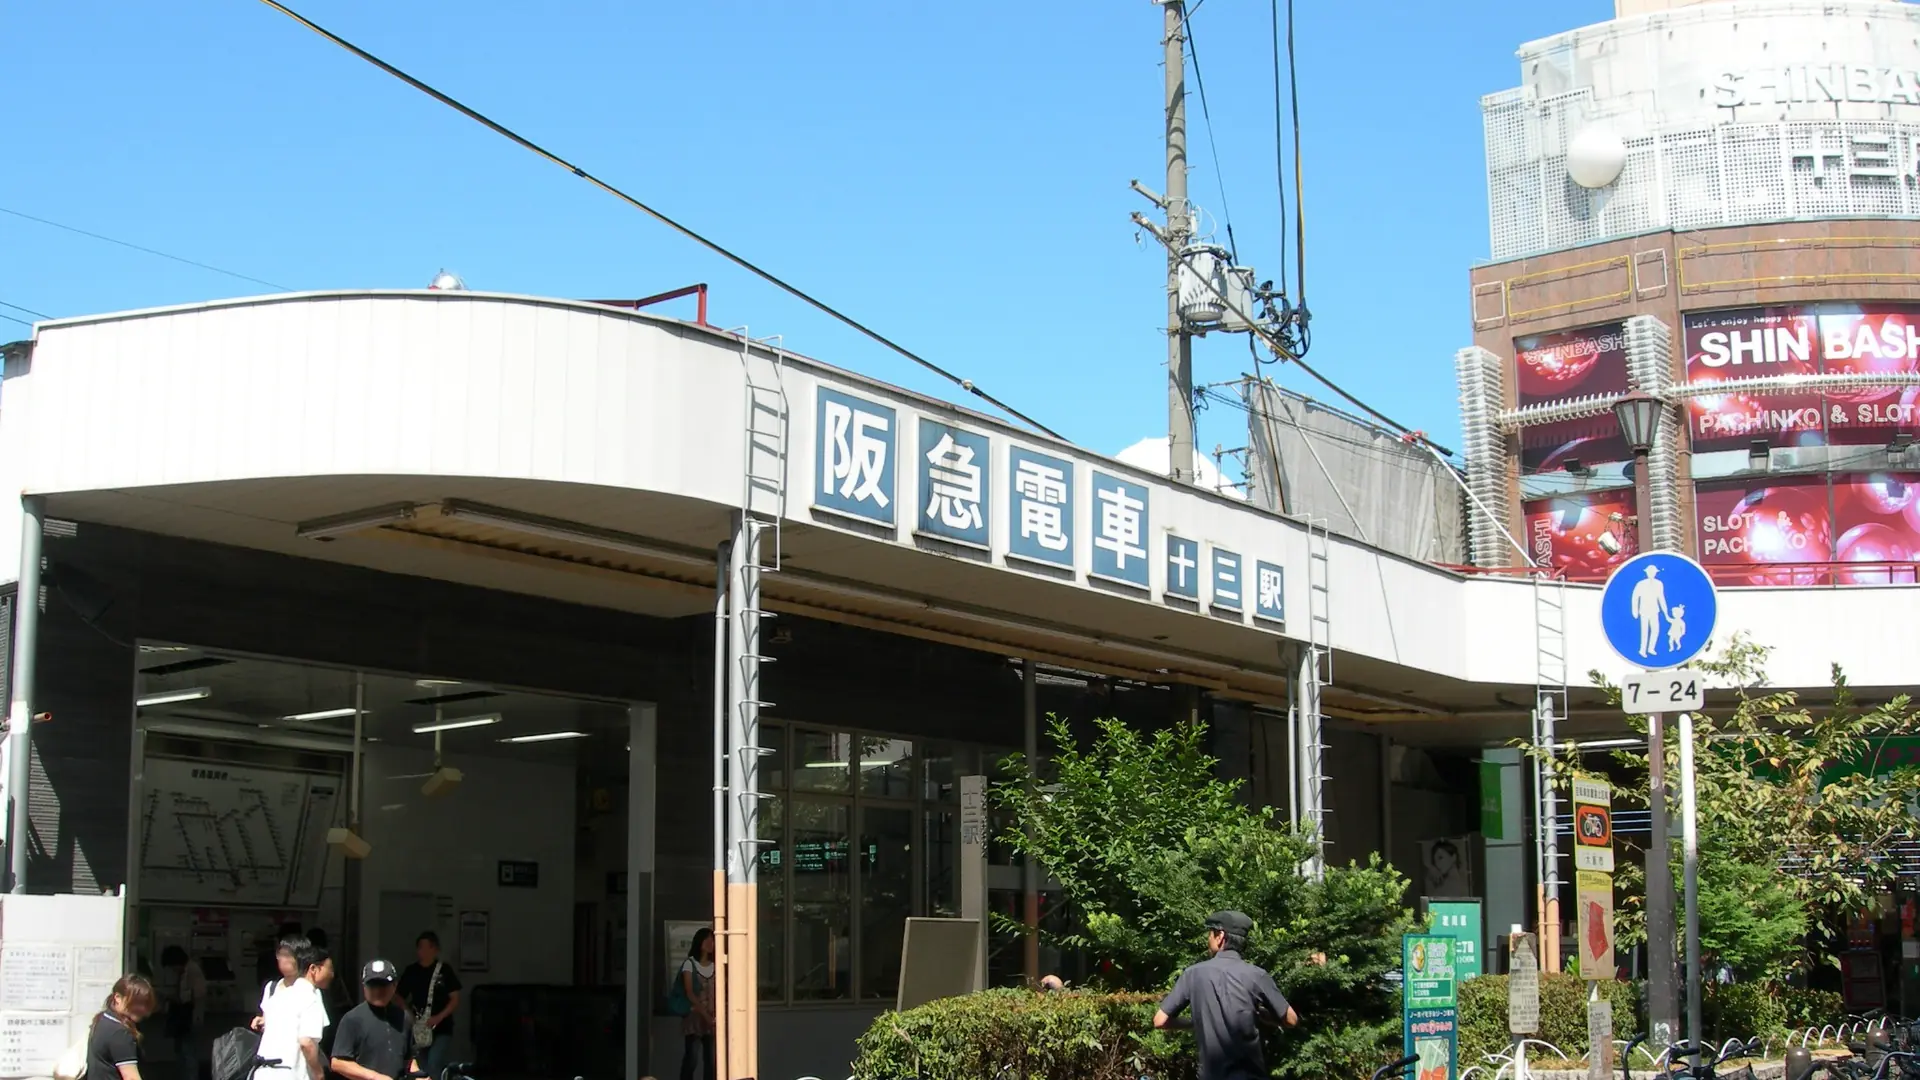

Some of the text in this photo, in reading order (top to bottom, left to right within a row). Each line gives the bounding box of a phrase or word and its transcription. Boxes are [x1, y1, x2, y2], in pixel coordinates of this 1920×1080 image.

[1714, 64, 1920, 107] SHINBA
[1721, 316, 1748, 326] enjoy
[1754, 315, 1782, 323] happy
[1700, 327, 1810, 367] SHIN
[1700, 404, 1915, 434] PACHINKO & SLOT
[824, 401, 1283, 612] 阪急電車 十三駅
[1703, 512, 1754, 532] SLOT
[1535, 519, 1553, 579] ASHI
[962, 787, 979, 844] 十三駅
